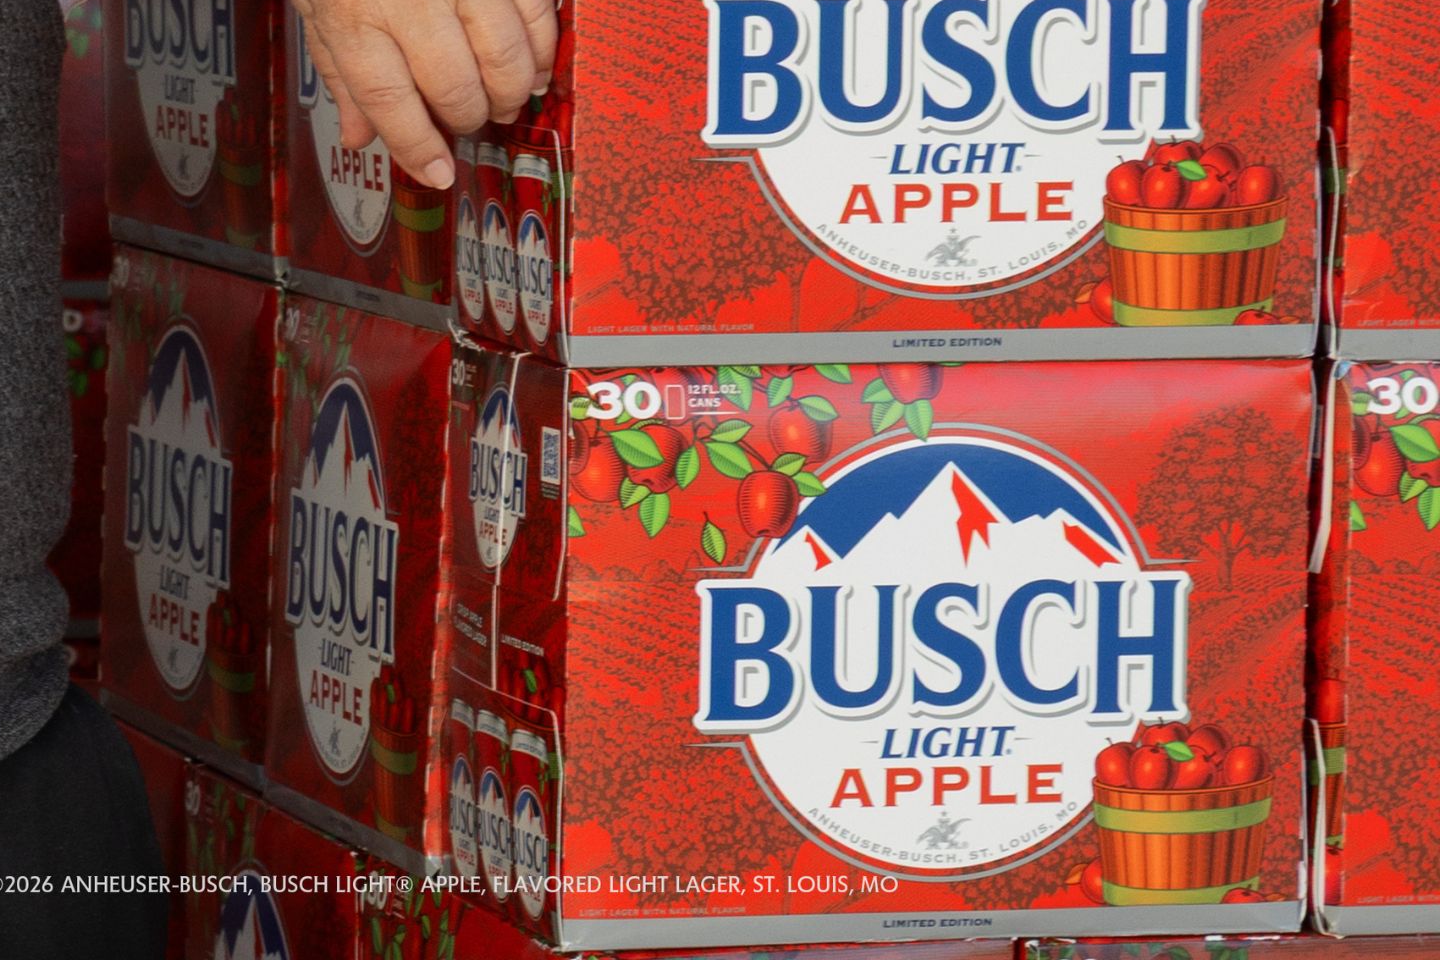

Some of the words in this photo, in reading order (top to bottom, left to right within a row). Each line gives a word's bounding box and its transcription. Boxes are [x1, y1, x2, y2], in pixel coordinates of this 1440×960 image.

[164, 73, 195, 105] LIGHT
[155, 105, 210, 149] APPLE
[330, 144, 384, 193] APPLE
[888, 142, 1026, 175] LIGHT
[837, 181, 1074, 224] APPLE
[816, 223, 971, 281] ANHEUSER-BUSCH,
[977, 267, 1002, 279] ST.
[1008, 242, 1065, 271] LOUIS,
[1066, 219, 1089, 241] MO
[892, 337, 947, 349] LIMITED
[950, 336, 1003, 348] EDITION
[587, 381, 662, 420] 30
[687, 397, 722, 408] CANS
[1366, 376, 1439, 415] 30
[470, 440, 527, 515] BUSCH
[126, 431, 231, 584] BUSCH
[161, 563, 191, 594] LIGHT
[287, 495, 398, 656] BUSCH
[147, 592, 201, 647] APPLE
[321, 638, 353, 677] LIGHT
[706, 580, 1184, 723] BUSCH
[309, 668, 364, 726] APPLE
[879, 725, 1016, 760] LIGHT
[829, 763, 1063, 809] APPLE
[808, 806, 963, 863] ANHEUSER-BUSCH,
[968, 850, 993, 862] ST.
[999, 823, 1055, 852] LOUIS,
[1056, 800, 1079, 822] MO
[882, 918, 937, 929] LIMITED
[939, 917, 993, 928] EDITION
